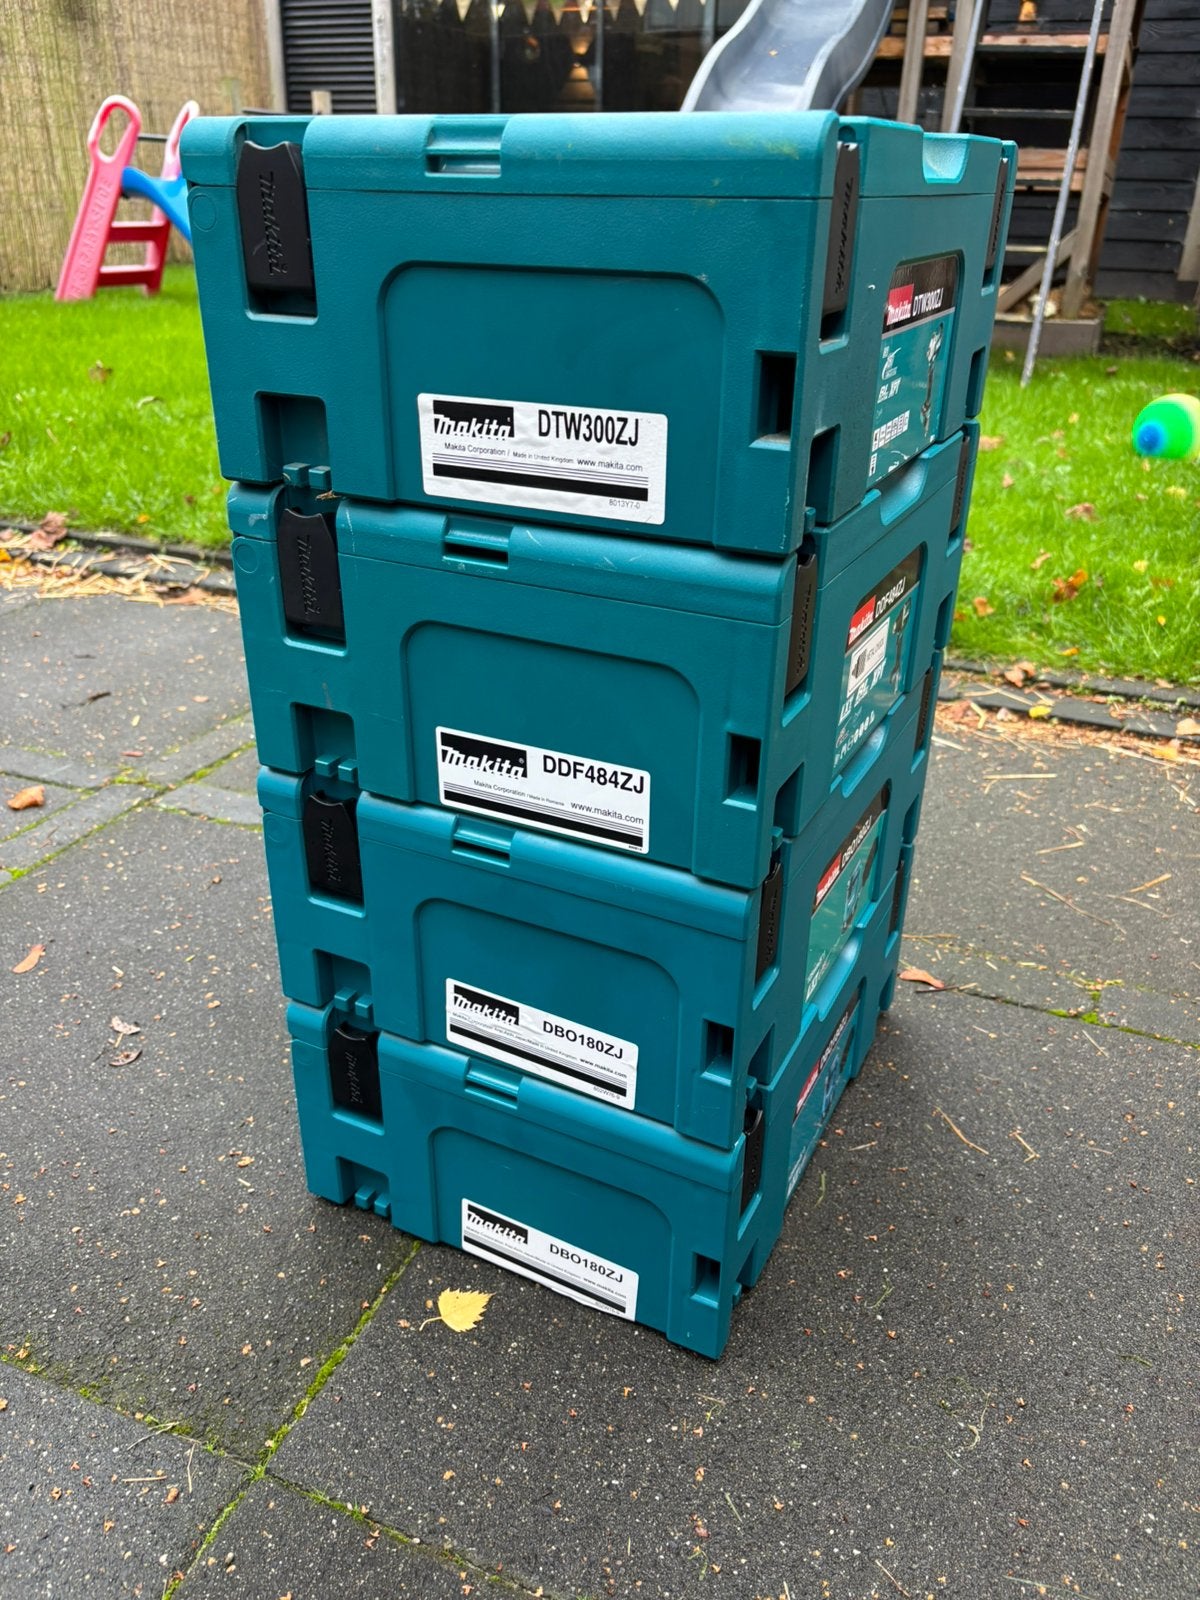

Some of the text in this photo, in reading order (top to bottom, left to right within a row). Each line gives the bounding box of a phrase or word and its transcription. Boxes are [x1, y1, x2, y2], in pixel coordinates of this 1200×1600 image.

[538, 409, 639, 446] DTW300ZJ
[445, 442, 466, 452] Makita
[467, 444, 506, 456] Corporation
[577, 458, 643, 472] www.makita.com
[543, 754, 645, 794] DDF484ZJ
[493, 784, 526, 797] Corporation
[571, 801, 644, 825] www.makita.com
[542, 1020, 623, 1060] DBO180ZJ
[550, 1243, 623, 1283] DBO180ZJ
